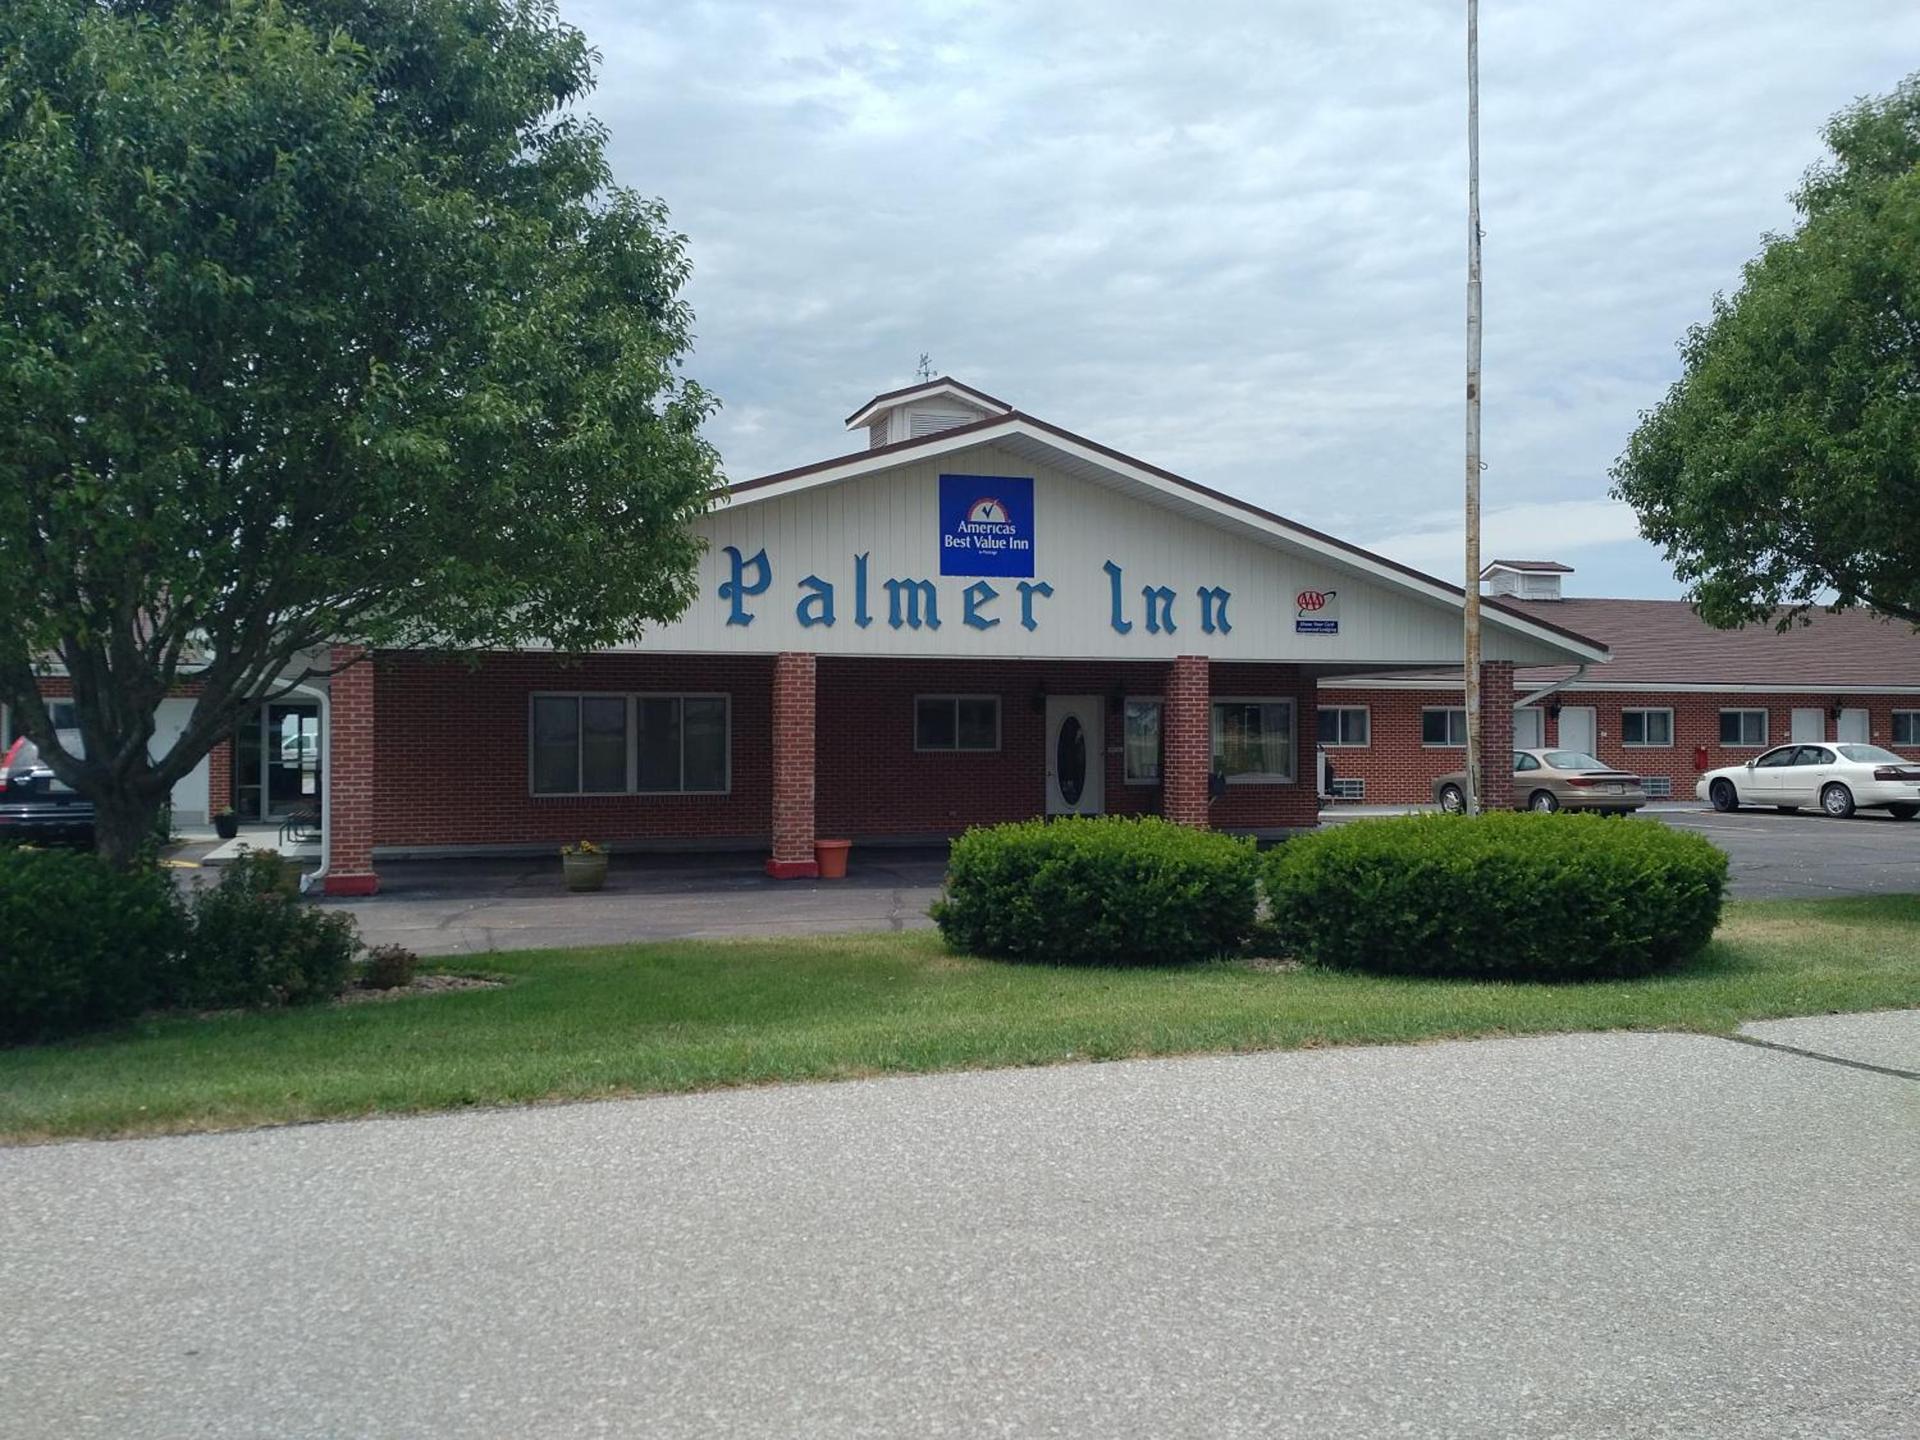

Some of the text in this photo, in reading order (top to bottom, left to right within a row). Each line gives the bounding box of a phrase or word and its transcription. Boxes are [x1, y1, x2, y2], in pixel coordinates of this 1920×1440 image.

[958, 521, 1016, 534] Americas
[945, 534, 1029, 549] Best Value Inn
[717, 545, 1233, 636] Palmer Inn
[1299, 592, 1324, 610] AAA
